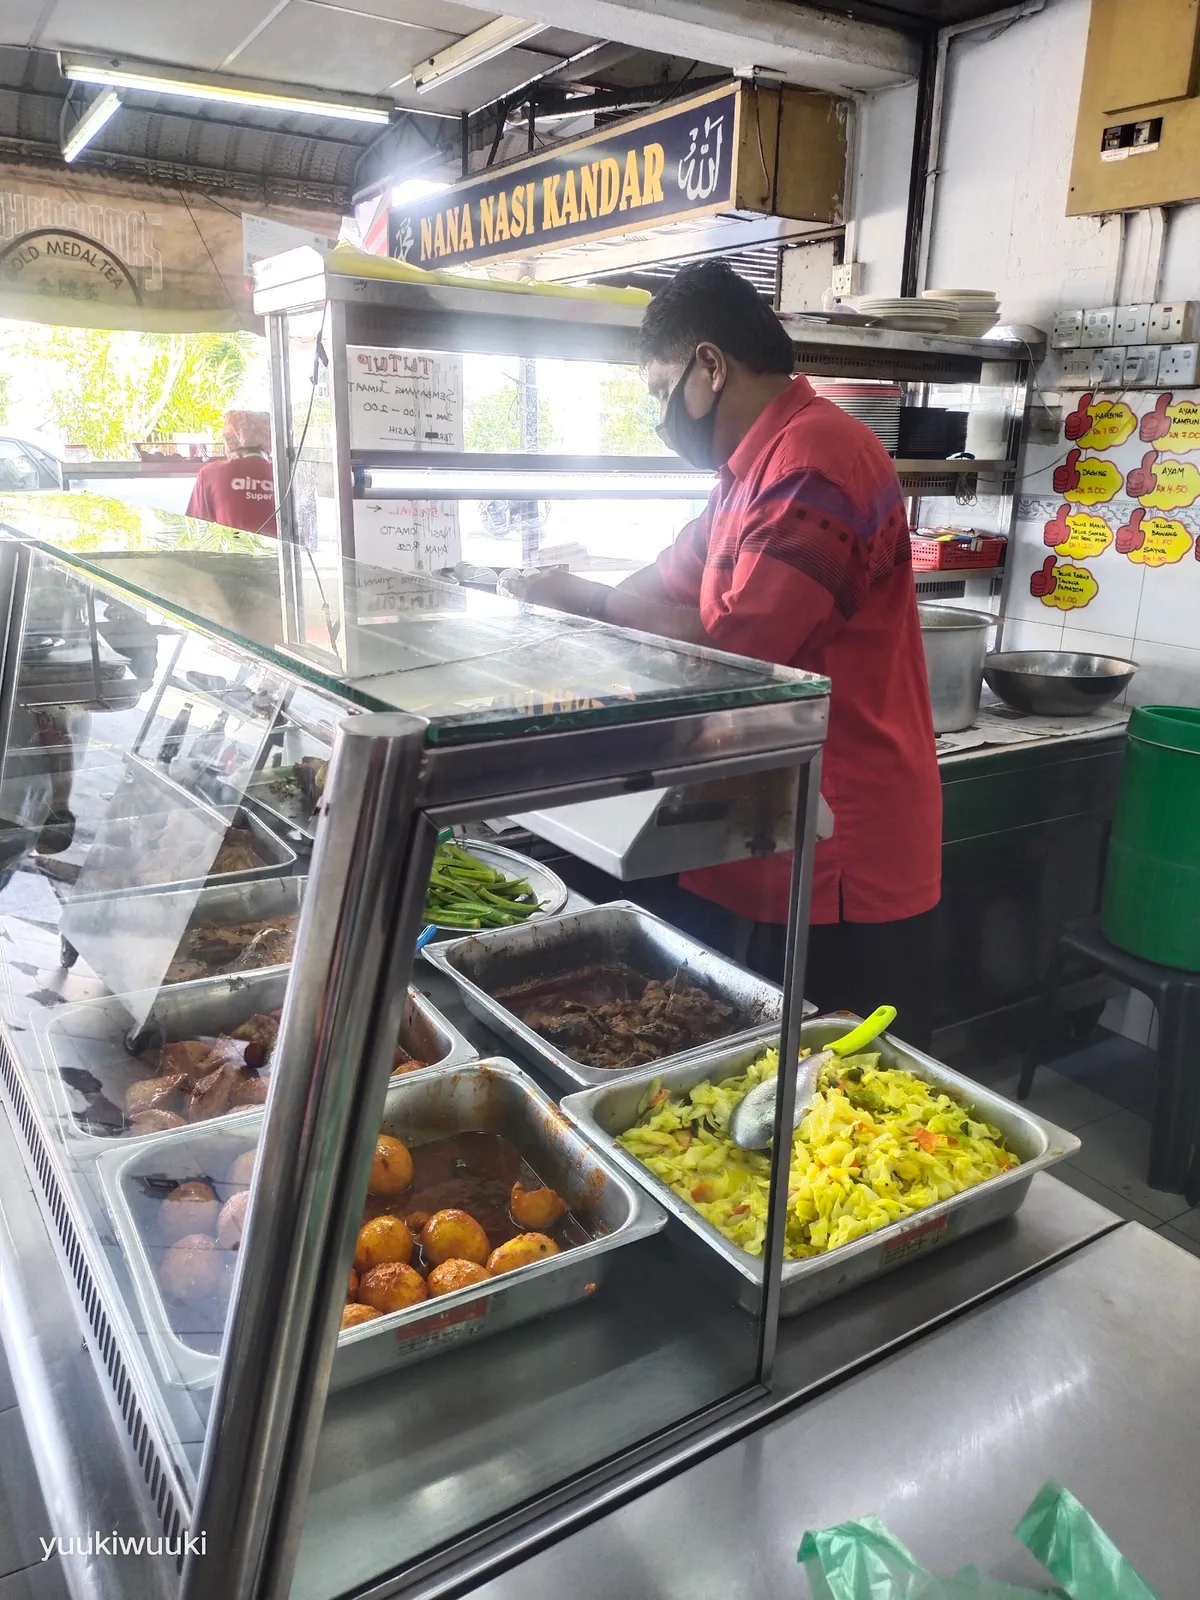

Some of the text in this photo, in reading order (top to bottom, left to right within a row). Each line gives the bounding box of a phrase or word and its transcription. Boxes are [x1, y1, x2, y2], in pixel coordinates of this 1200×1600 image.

[420, 142, 665, 261] NANA NASI KANDAR
[46, 241, 97, 268] MEDAL
[99, 259, 124, 290] TEA
[1095, 411, 1123, 420] KAMBING
[1178, 407, 1198, 416] AYAM
[1168, 431, 1179, 439] RM
[1082, 468, 1107, 477] DAGING
[1161, 466, 1185, 479] AYAM
[1156, 484, 1188, 494] RM 4.50
[245, 491, 273, 502] Super
[1151, 521, 1175, 529] TELUR
[1151, 529, 1178, 537] BAWANG
[1143, 546, 1167, 555] SAYUR
